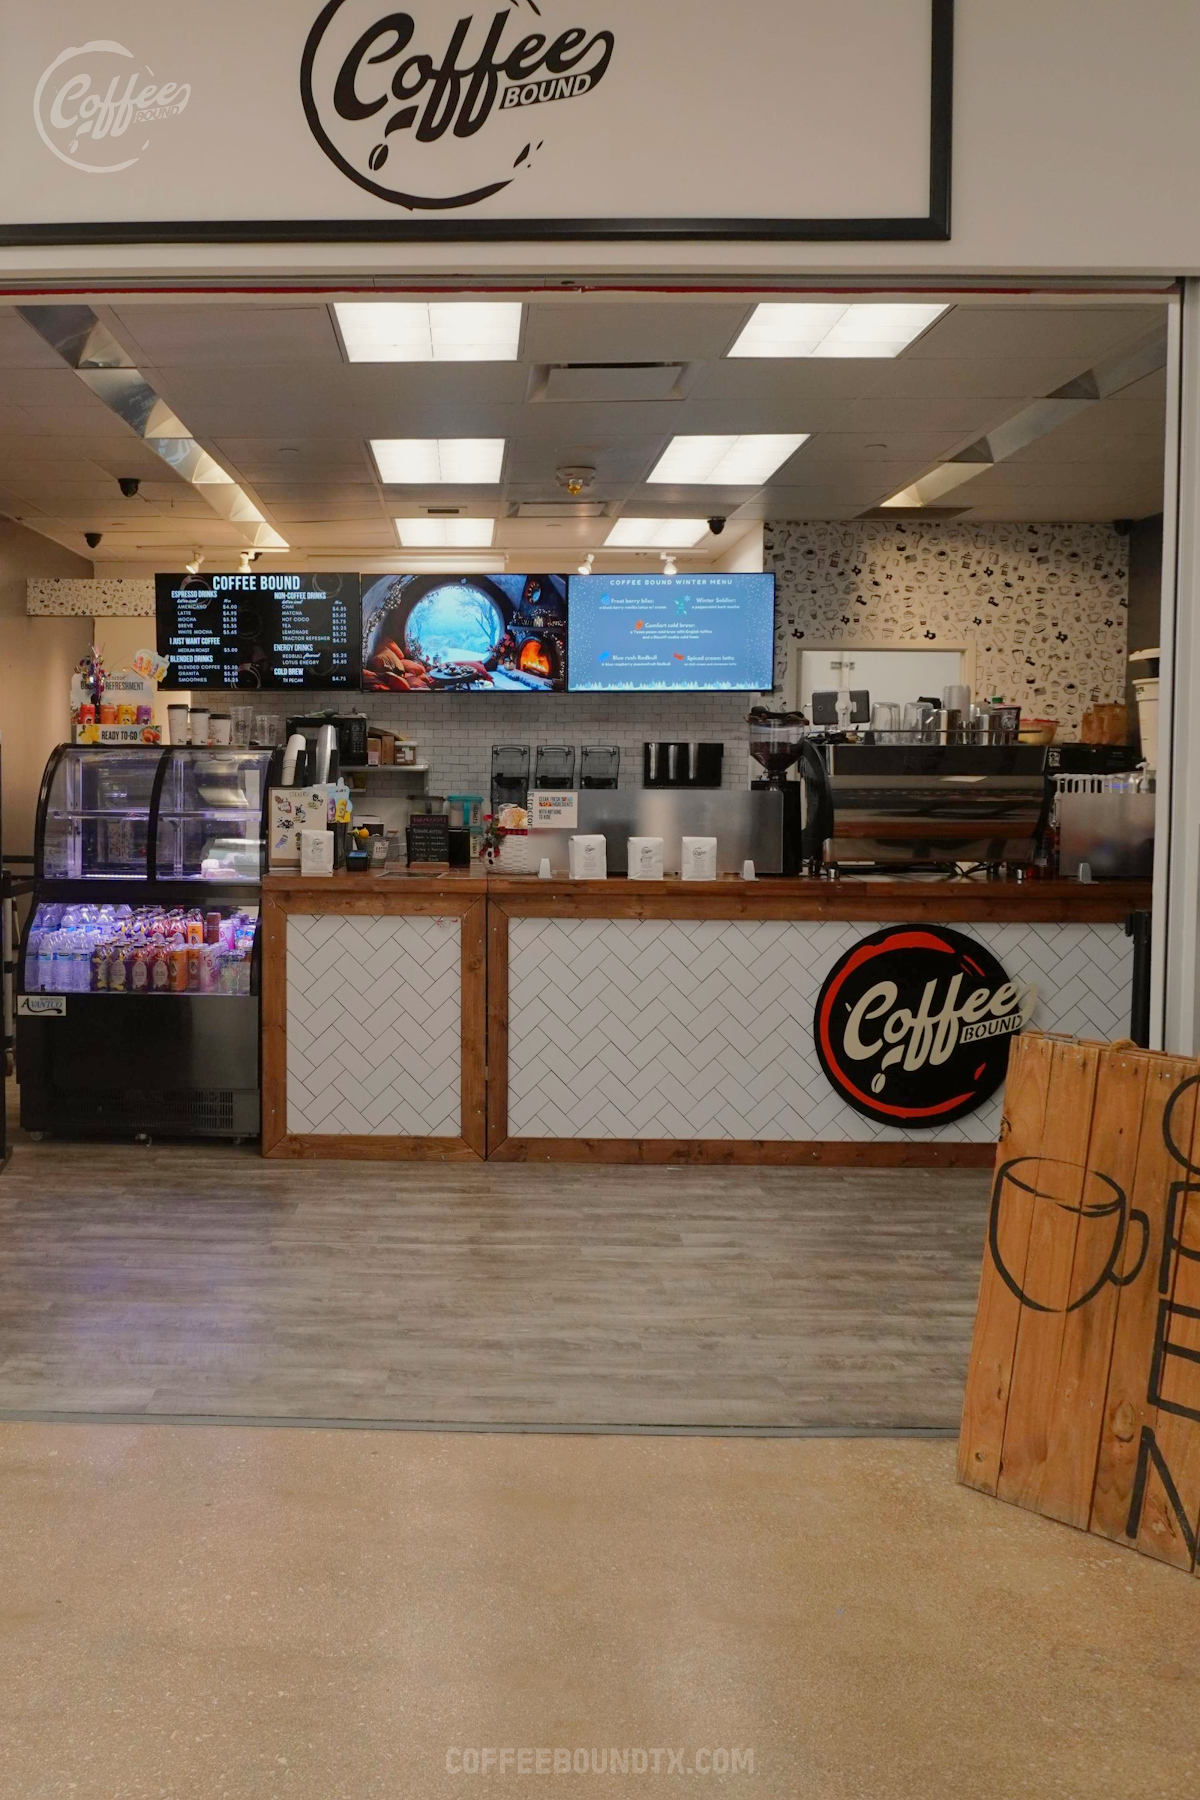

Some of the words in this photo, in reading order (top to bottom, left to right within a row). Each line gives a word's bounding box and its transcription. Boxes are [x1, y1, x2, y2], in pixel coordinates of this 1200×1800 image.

[334, 8, 614, 142] Coffee
[500, 74, 592, 110] BOUND
[213, 576, 256, 590] COFFEE
[260, 576, 300, 590] BOUND
[171, 590, 197, 598] ESPRESSO
[198, 590, 218, 598] DRINKS
[173, 637, 184, 645] JUST
[186, 637, 200, 645] WANT
[201, 637, 220, 645] COFFEE
[274, 643, 293, 651] ENERGY
[294, 643, 313, 651] DRINKS
[274, 667, 287, 675] COLD
[288, 667, 304, 675] BREW
[105, 682, 144, 691] REFRESHMENT
[102, 731, 119, 740] READY
[121, 731, 138, 740] TO-GO
[21, 998, 62, 1013] AVANTCO
[843, 972, 1037, 1071] Coffee
[960, 1014, 1026, 1043] BOUND
